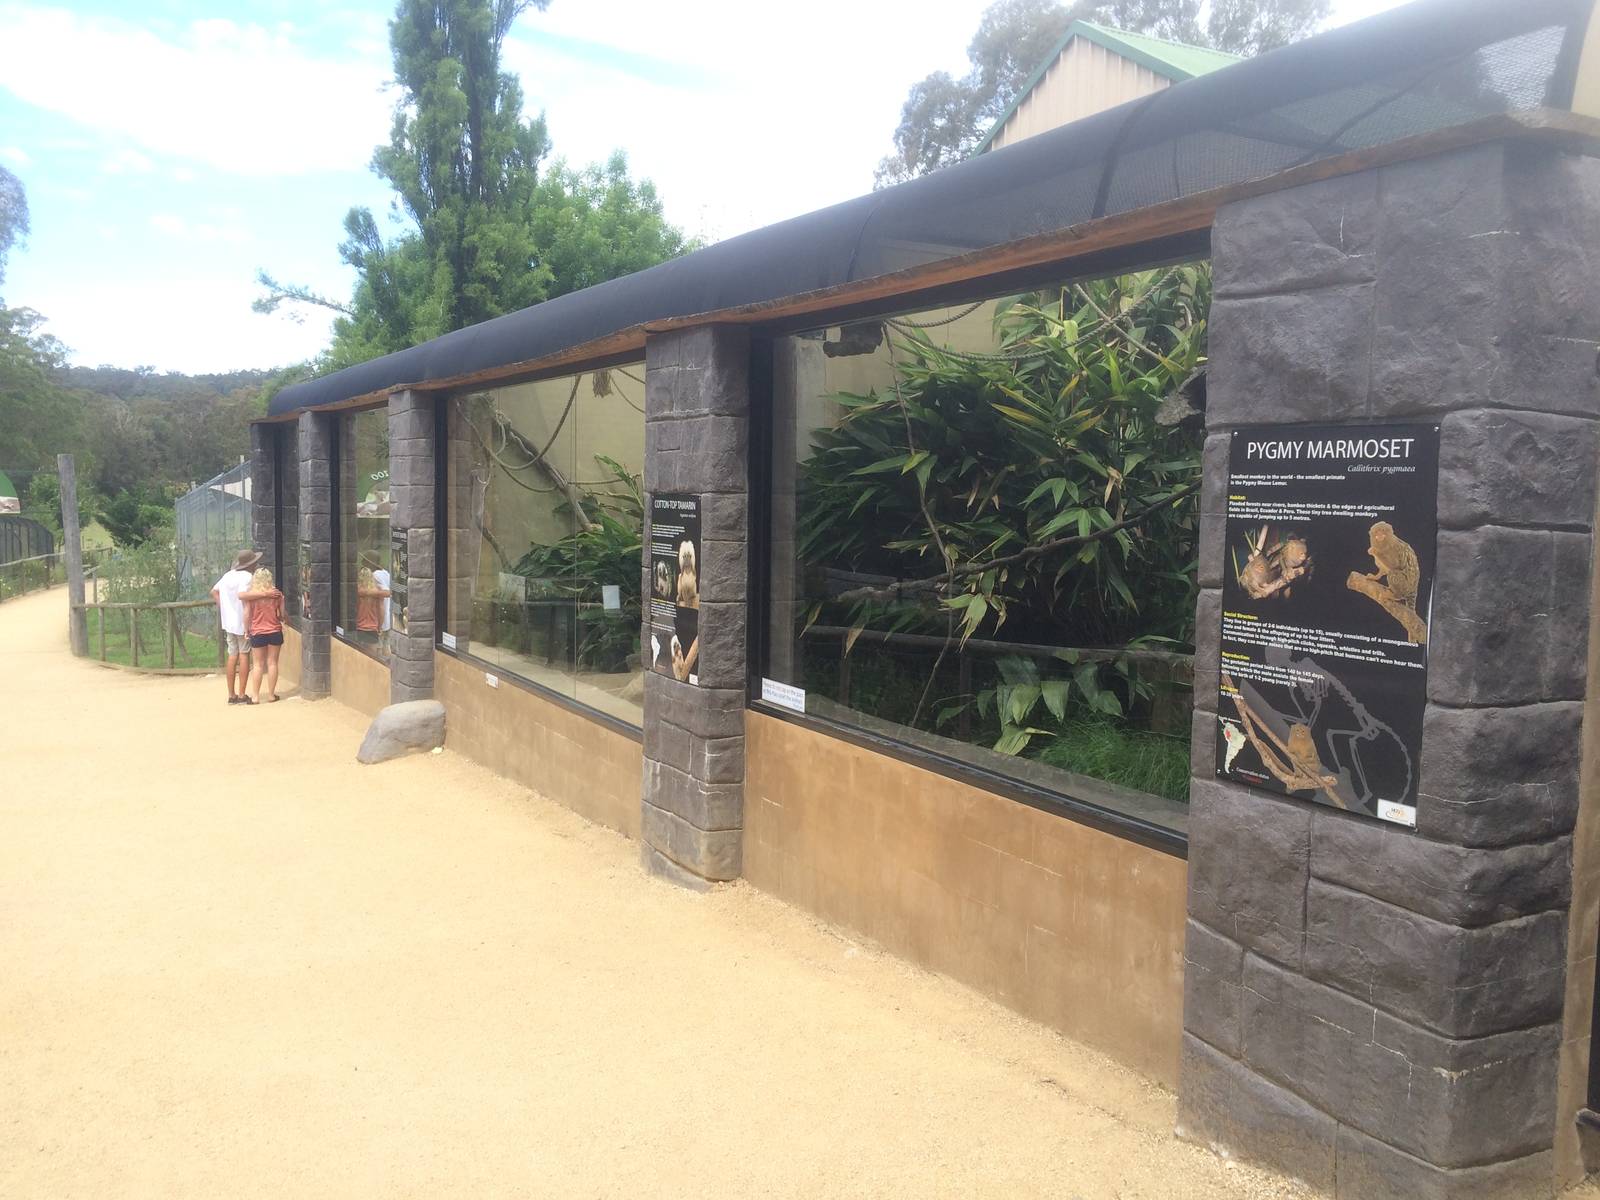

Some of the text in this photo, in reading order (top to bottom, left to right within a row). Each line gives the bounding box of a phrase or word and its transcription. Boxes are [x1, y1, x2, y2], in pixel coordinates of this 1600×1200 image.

[1247, 438, 1415, 459] PYGMY MARMOSET
[1348, 464, 1415, 474] Callithrix pygmaea
